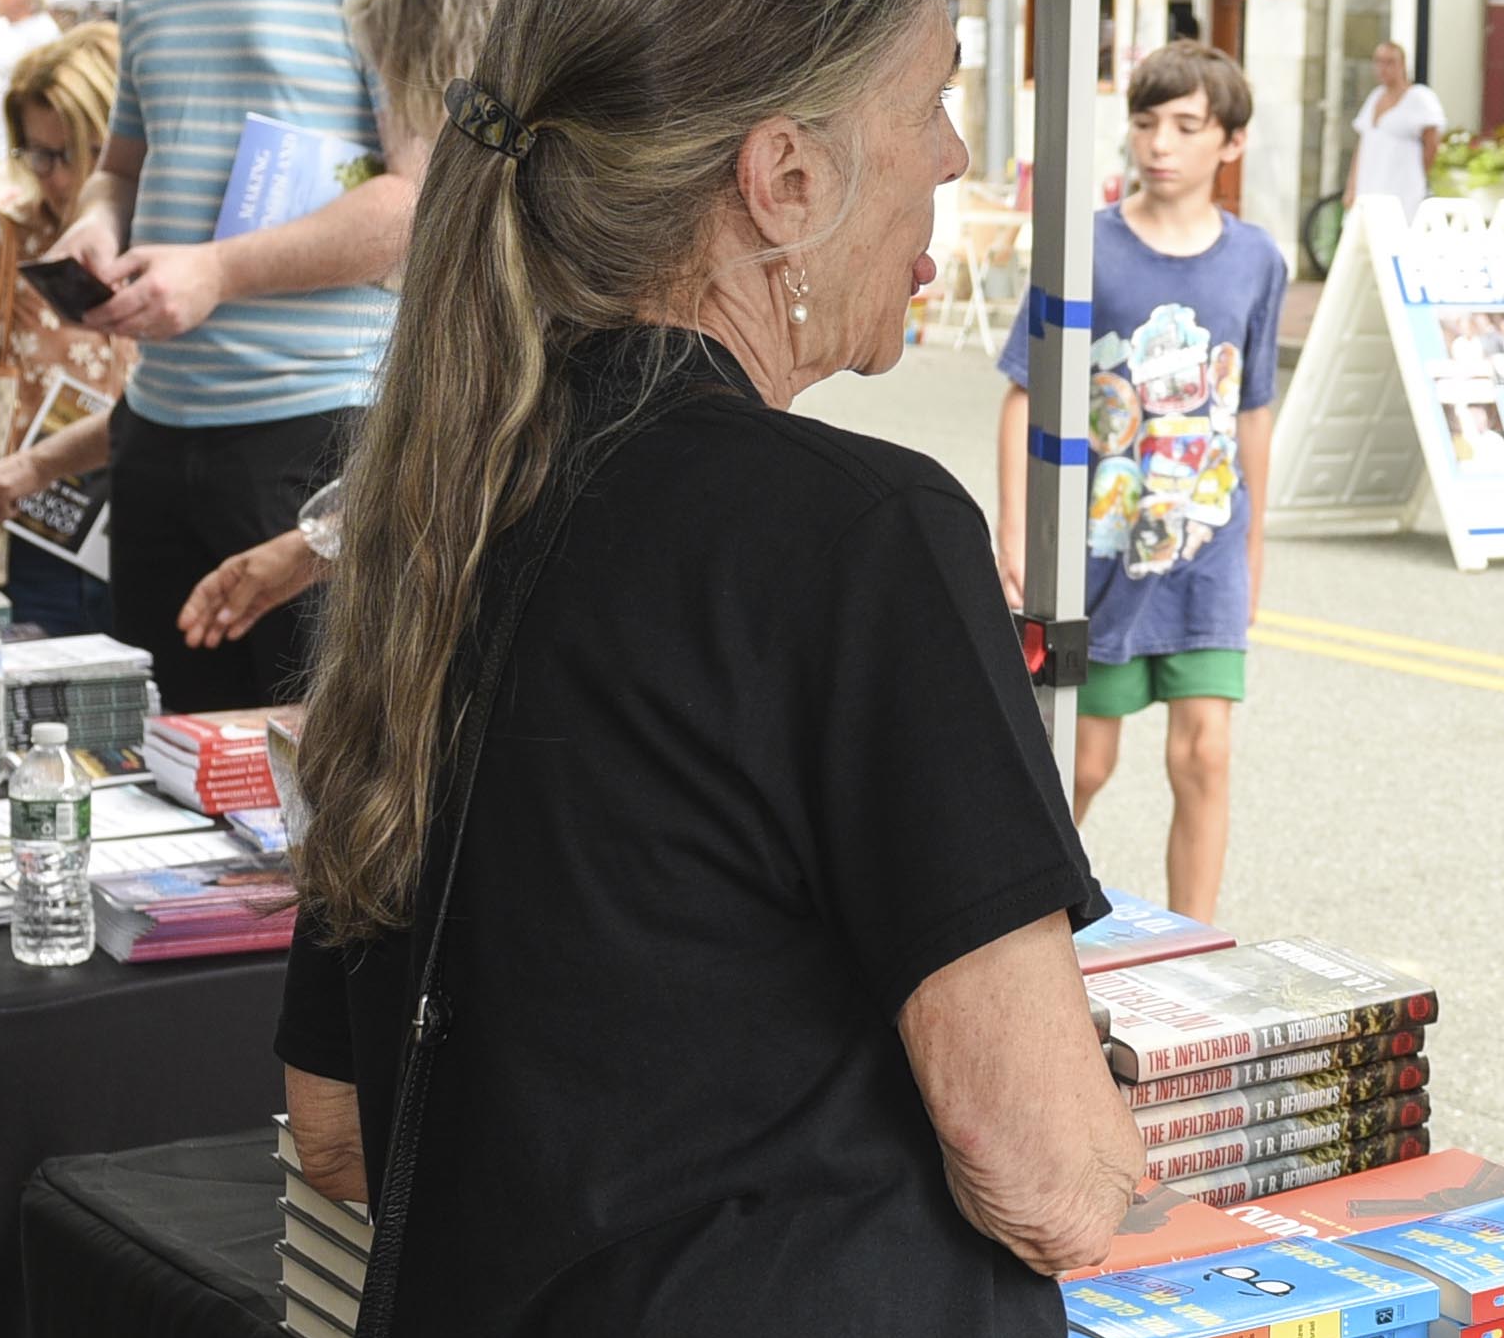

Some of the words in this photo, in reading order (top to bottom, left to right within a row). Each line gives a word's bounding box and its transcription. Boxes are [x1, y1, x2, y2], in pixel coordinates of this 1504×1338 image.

[1146, 1050, 1170, 1073] THE
[1174, 1032, 1250, 1068] INFILTRATOR
[1261, 1029, 1270, 1049] T.
[1272, 1025, 1285, 1046] R.
[1287, 1013, 1348, 1044] HENDRICKS
